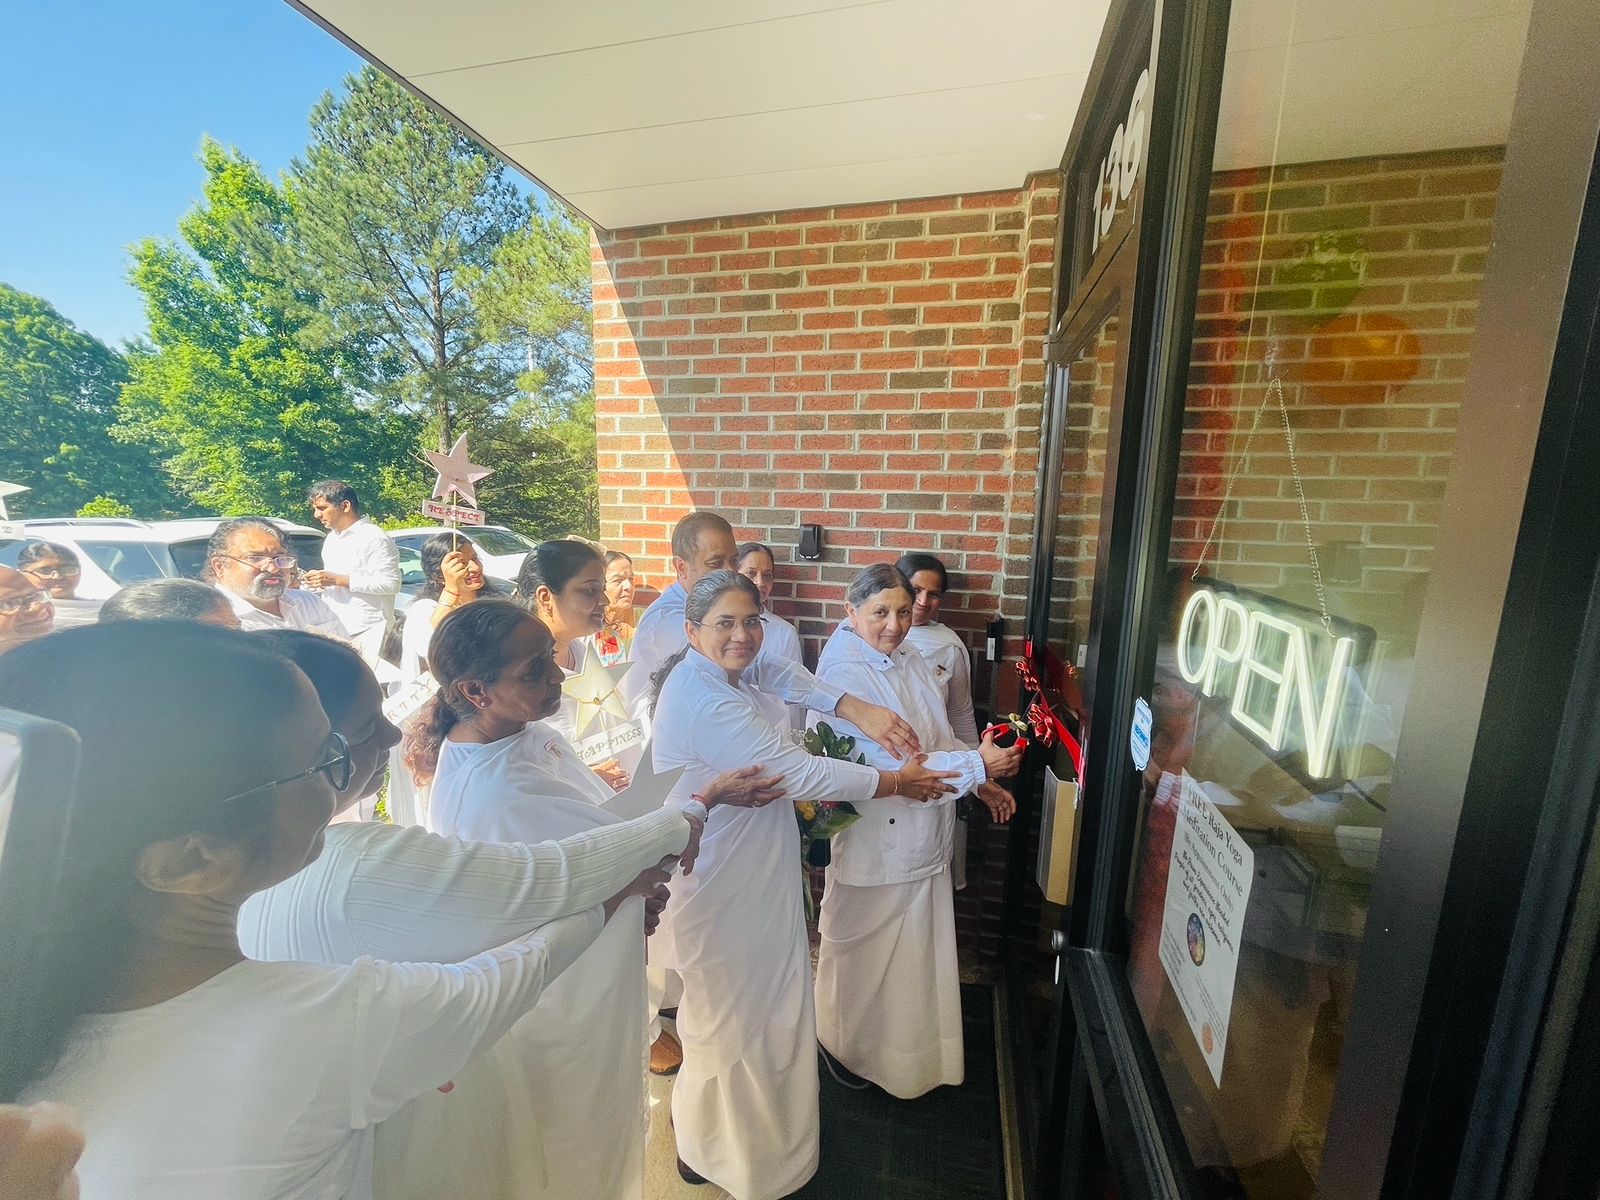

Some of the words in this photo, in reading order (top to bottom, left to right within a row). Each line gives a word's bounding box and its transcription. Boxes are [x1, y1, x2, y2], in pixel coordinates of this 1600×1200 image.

[1092, 68, 1148, 255] 136
[428, 504, 481, 521] RESPECT
[1177, 589, 1354, 778] OPEN
[1183, 805, 1216, 858] Meditation
[1217, 851, 1243, 897] Course
[1188, 784, 1207, 820] FREE
[1208, 811, 1224, 840] Raja
[1225, 831, 1243, 867] Yoga
